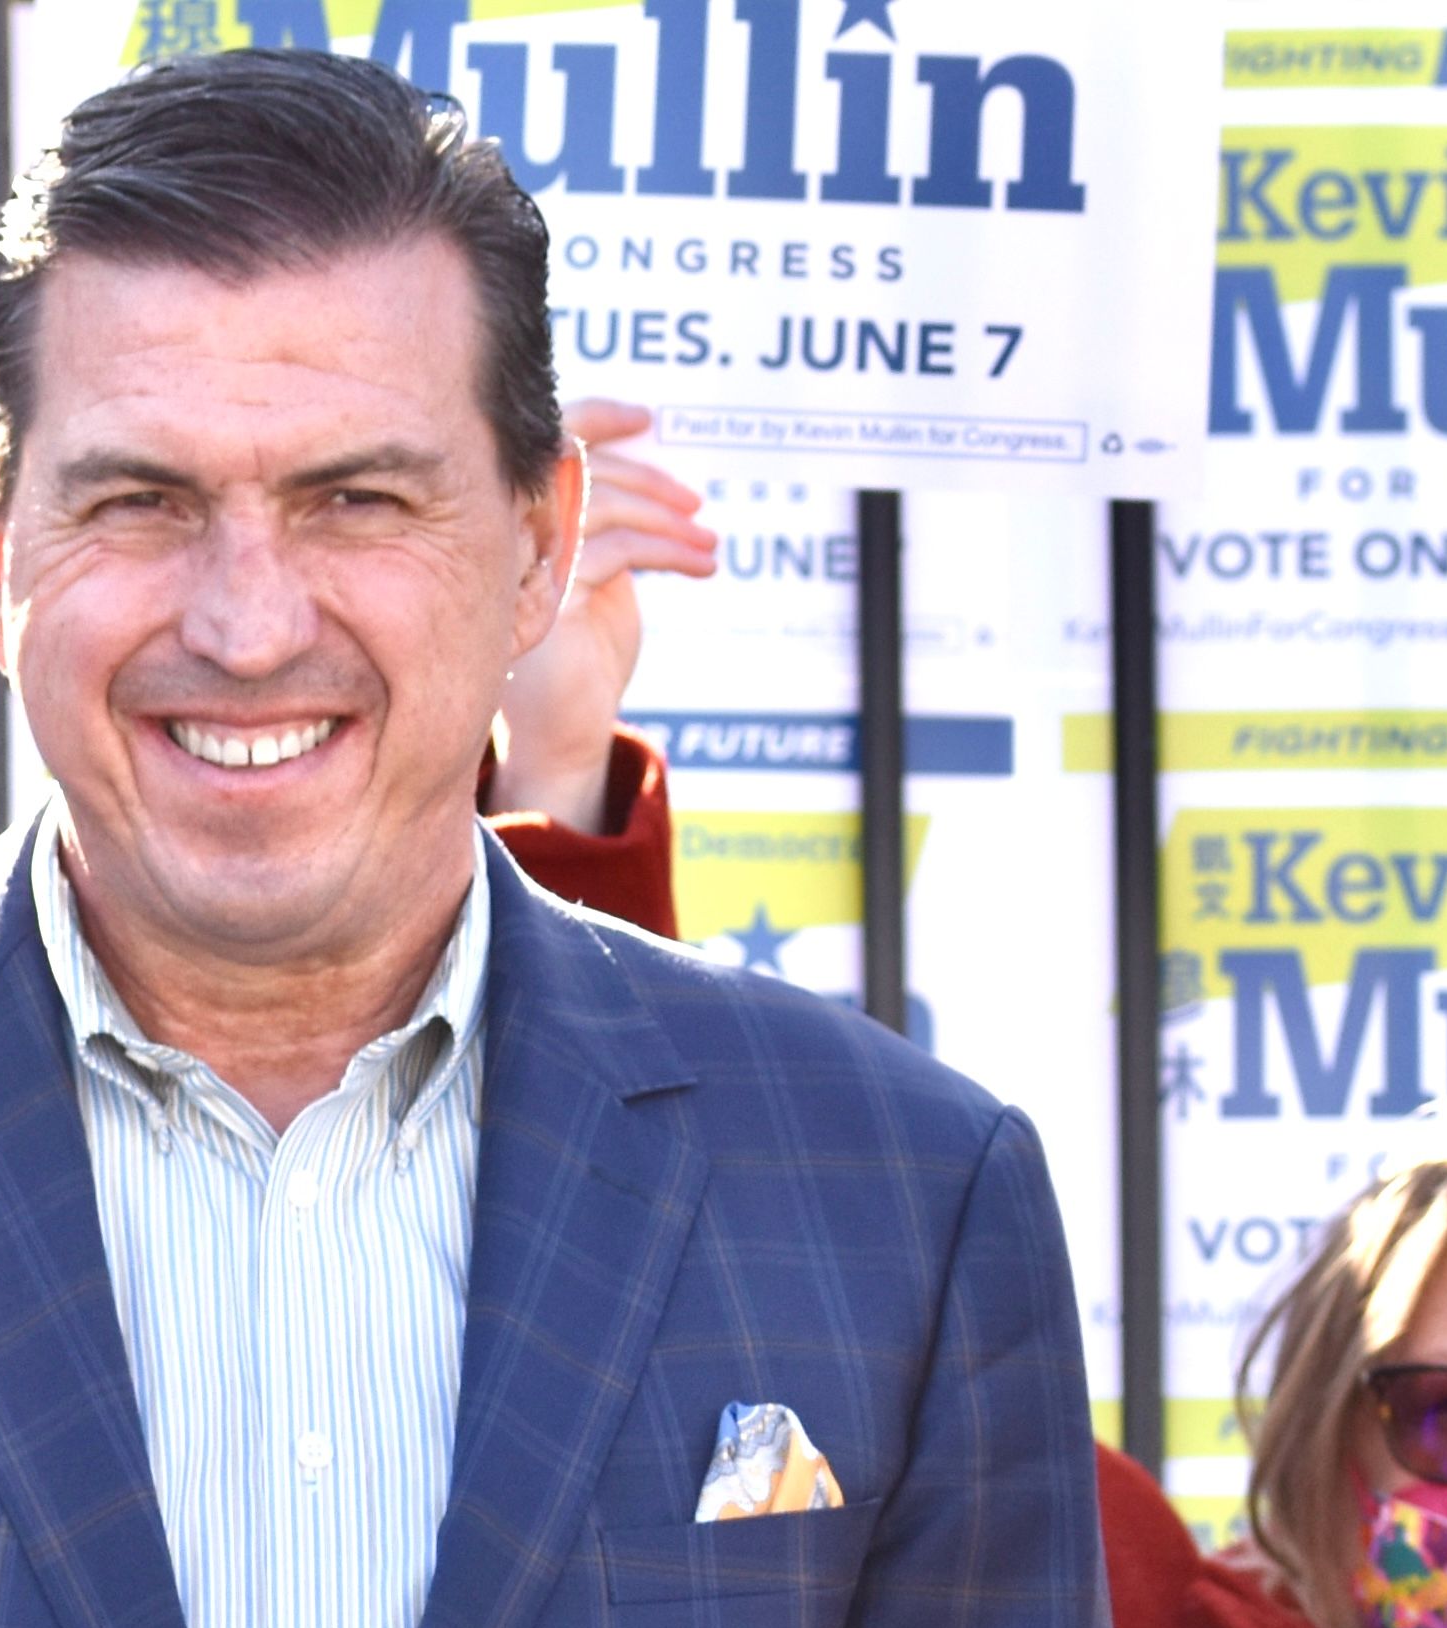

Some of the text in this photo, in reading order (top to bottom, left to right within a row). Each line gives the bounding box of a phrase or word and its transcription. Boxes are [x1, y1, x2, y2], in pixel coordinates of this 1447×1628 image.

[1225, 42, 1423, 74] IGHTING
[563, 235, 905, 283] ONGRESS
[758, 315, 957, 377] JUNE
[982, 324, 1025, 379] 7
[793, 417, 854, 442] Kevin
[858, 420, 925, 444] Mullin
[1297, 467, 1417, 503] FOR
[724, 533, 858, 583] UNE
[1159, 528, 1333, 580] VOTE
[677, 723, 855, 764] FUTURE
[1188, 1216, 1321, 1266] VOT
